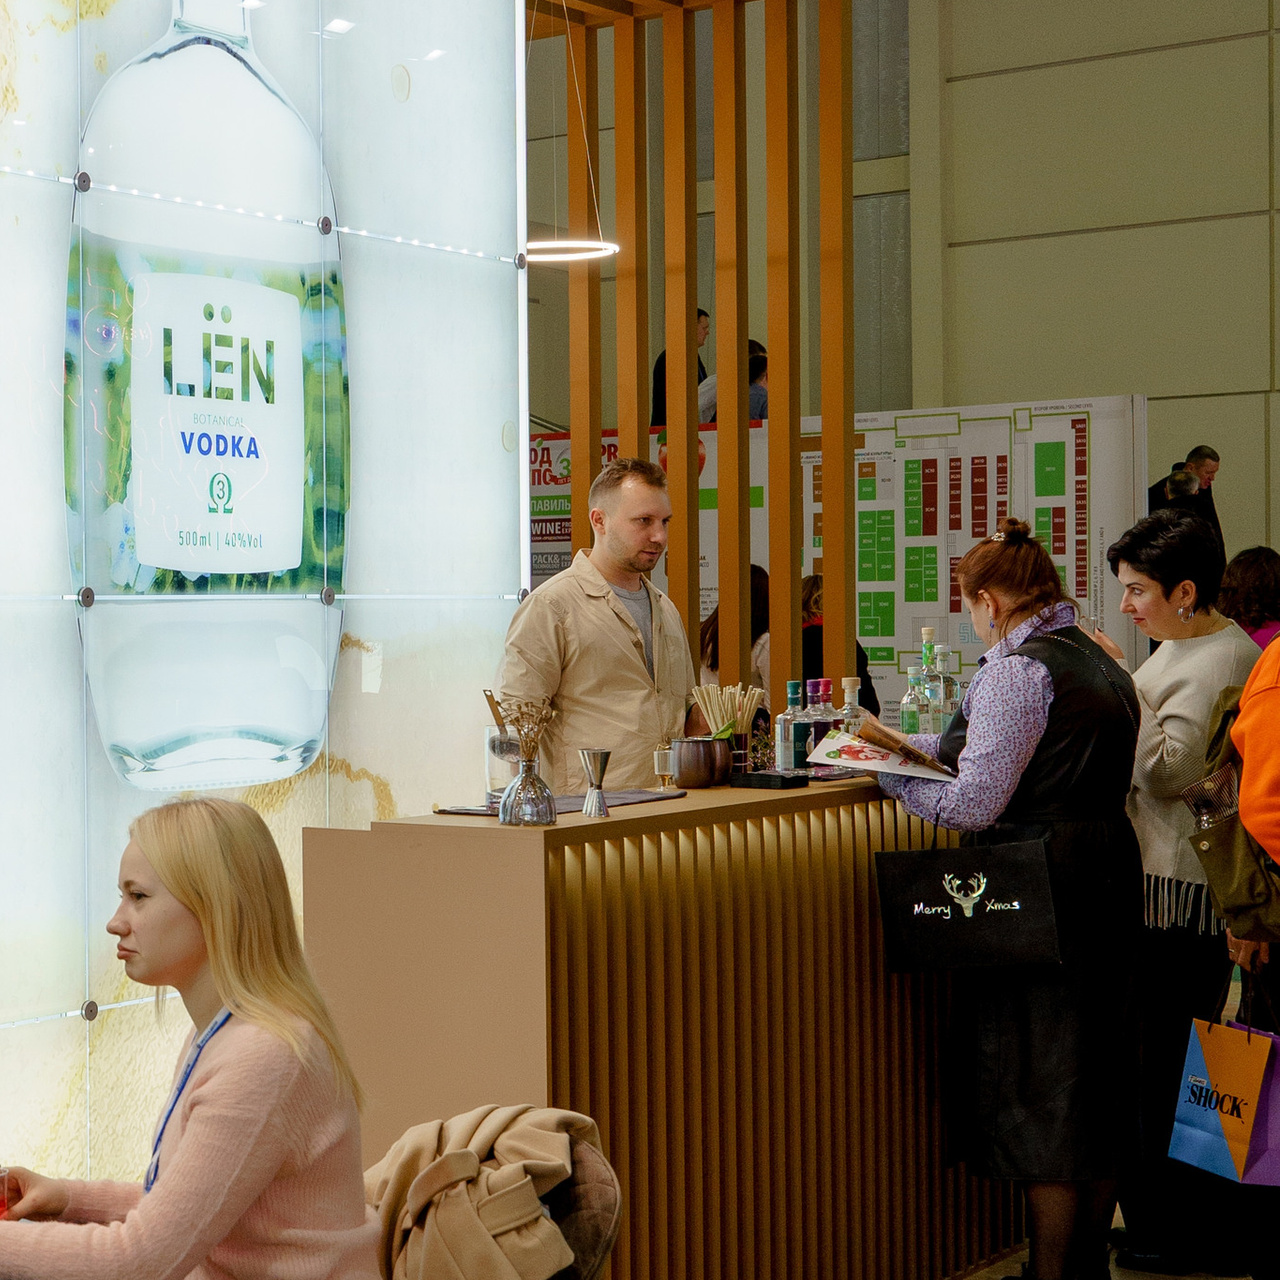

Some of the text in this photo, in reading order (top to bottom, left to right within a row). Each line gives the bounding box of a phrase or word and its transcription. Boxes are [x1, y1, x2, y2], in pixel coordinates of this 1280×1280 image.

[162, 302, 275, 405] LËN
[193, 412, 245, 428] BOTANICAL
[180, 431, 260, 459] VODKA
[531, 522, 561, 535] WINE
[178, 530, 263, 549] 500ml 40%Vol
[532, 554, 560, 564] PACK&
[913, 898, 1020, 920] Merry Xmas
[1188, 1083, 1244, 1119] SHOCK
